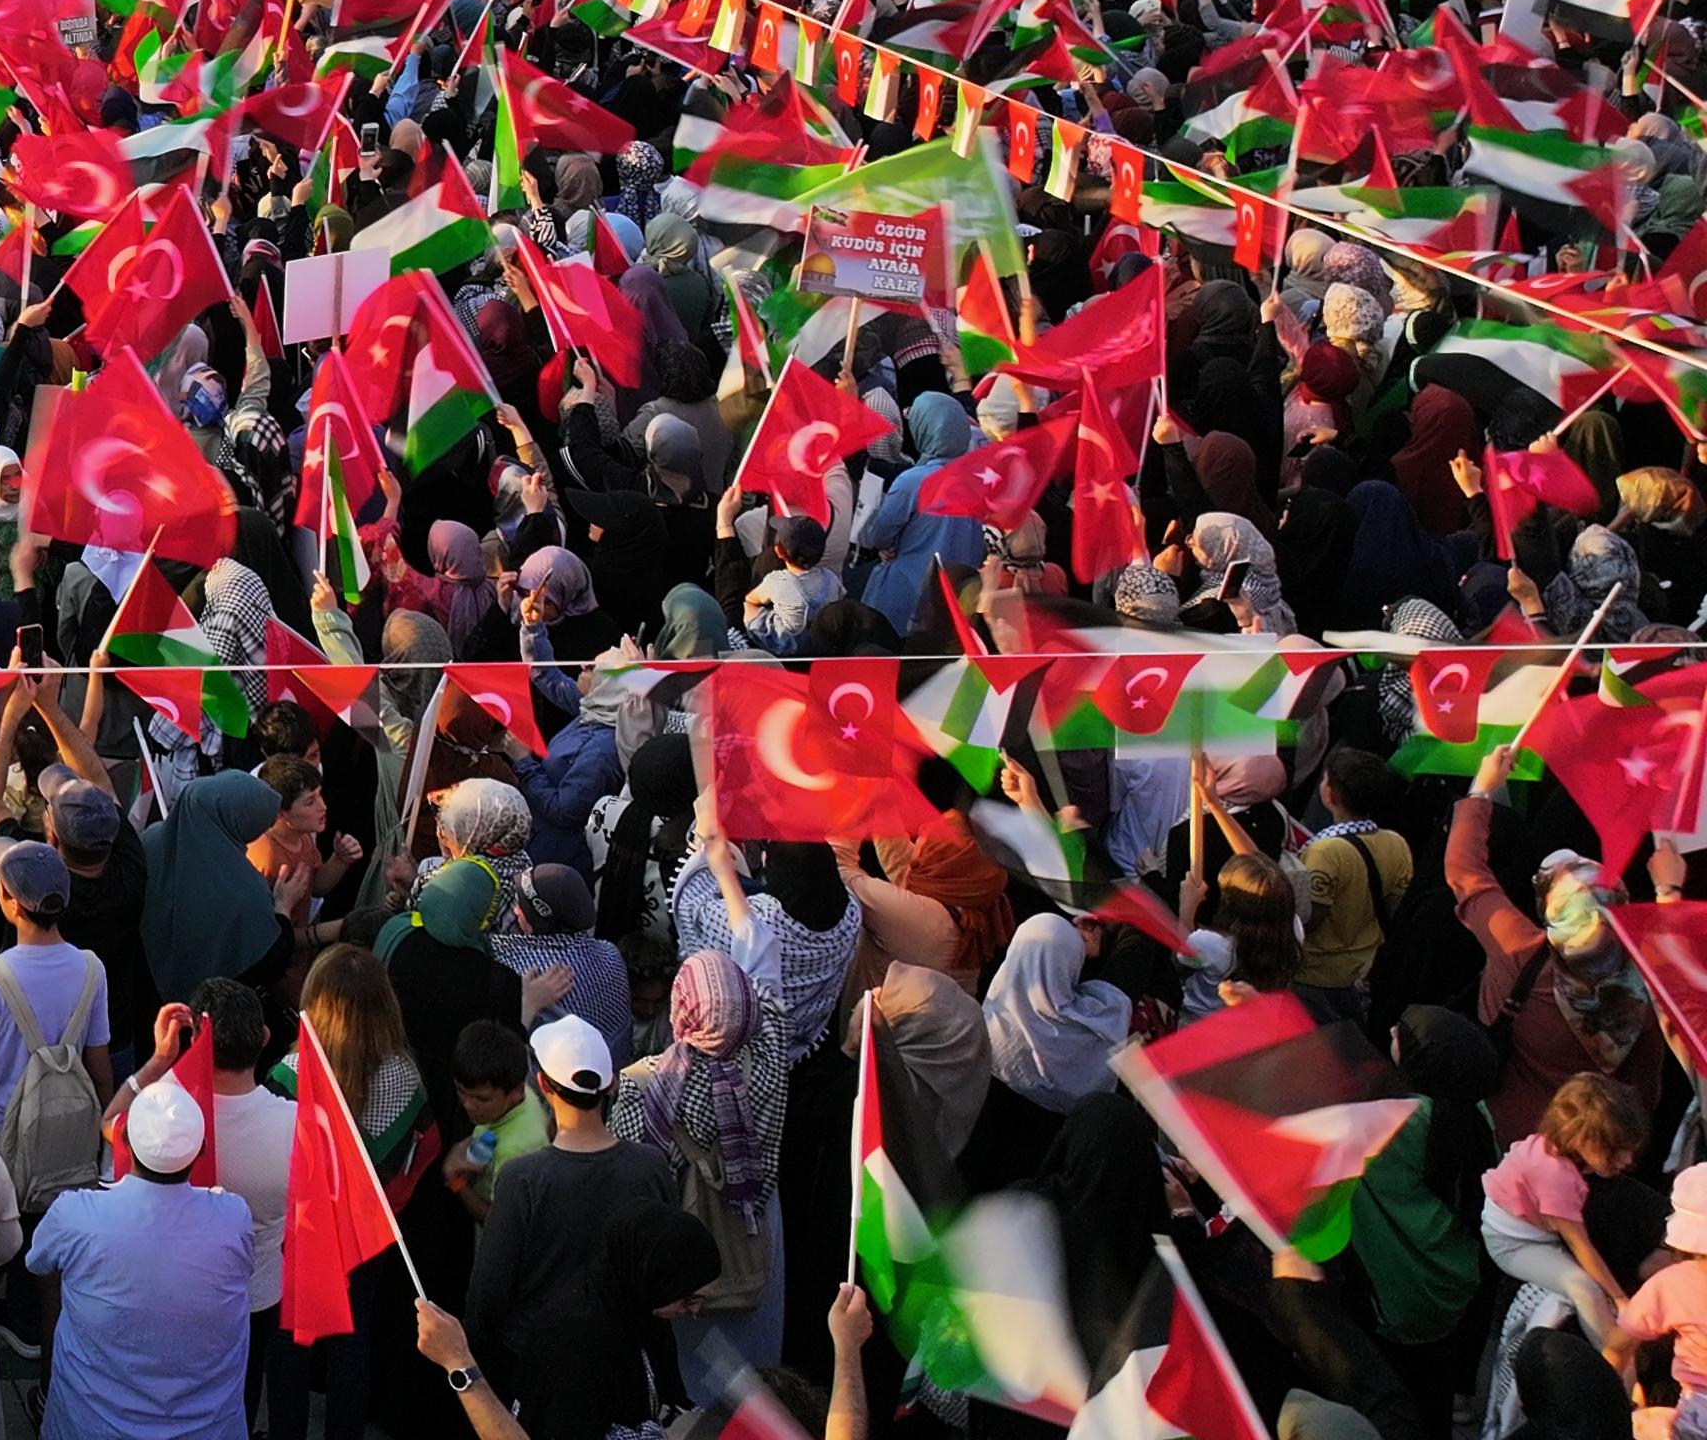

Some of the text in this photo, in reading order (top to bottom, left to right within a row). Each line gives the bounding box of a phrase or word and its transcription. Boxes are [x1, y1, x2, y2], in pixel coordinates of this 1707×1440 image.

[875, 220, 926, 241] ÖZGÜR
[830, 235, 924, 260] KUDÜS İÇİN
[868, 257, 920, 276] AYAĞA
[873, 275, 919, 294] KALK
